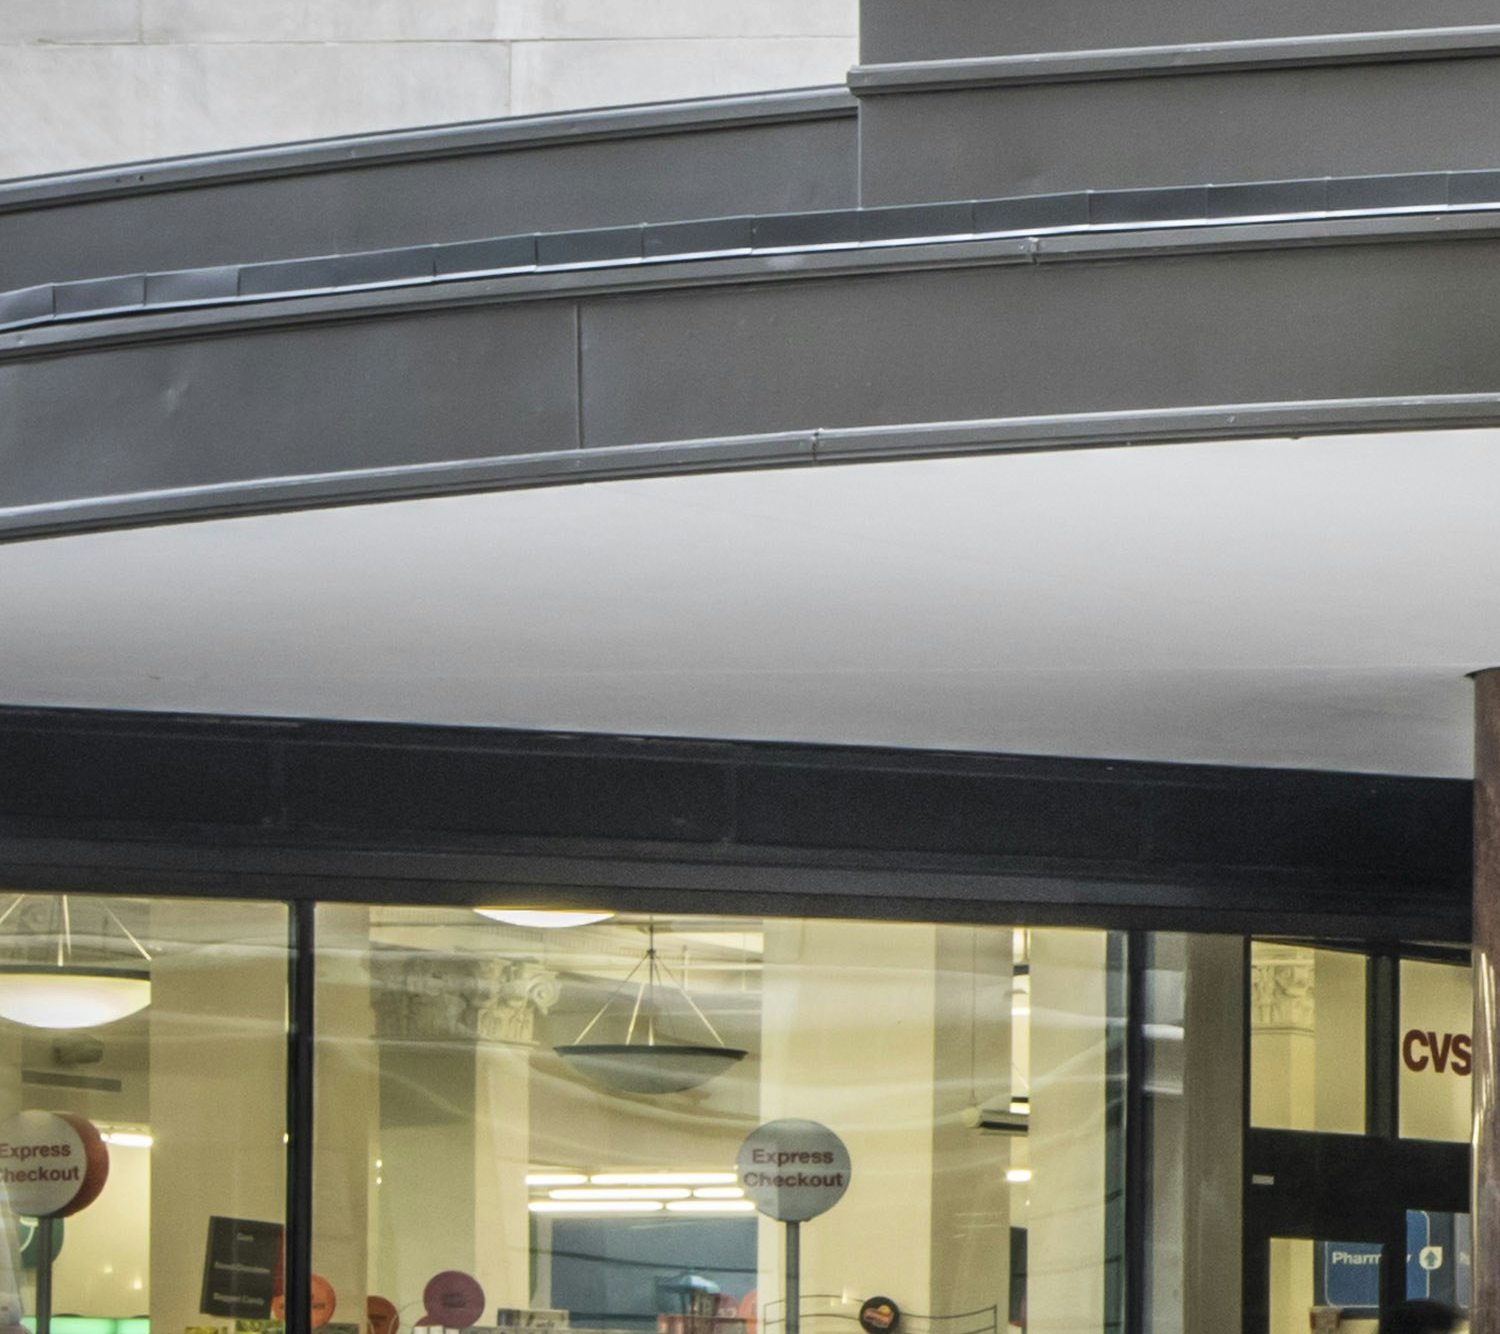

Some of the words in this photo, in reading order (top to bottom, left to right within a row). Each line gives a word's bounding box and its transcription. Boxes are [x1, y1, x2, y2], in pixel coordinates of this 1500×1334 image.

[1402, 1028, 1472, 1077] CVS
[0, 1142, 71, 1162] Express
[752, 1148, 834, 1168] Express
[743, 1171, 844, 1188] Checkout
[1331, 1250, 1411, 1267] Pharm
